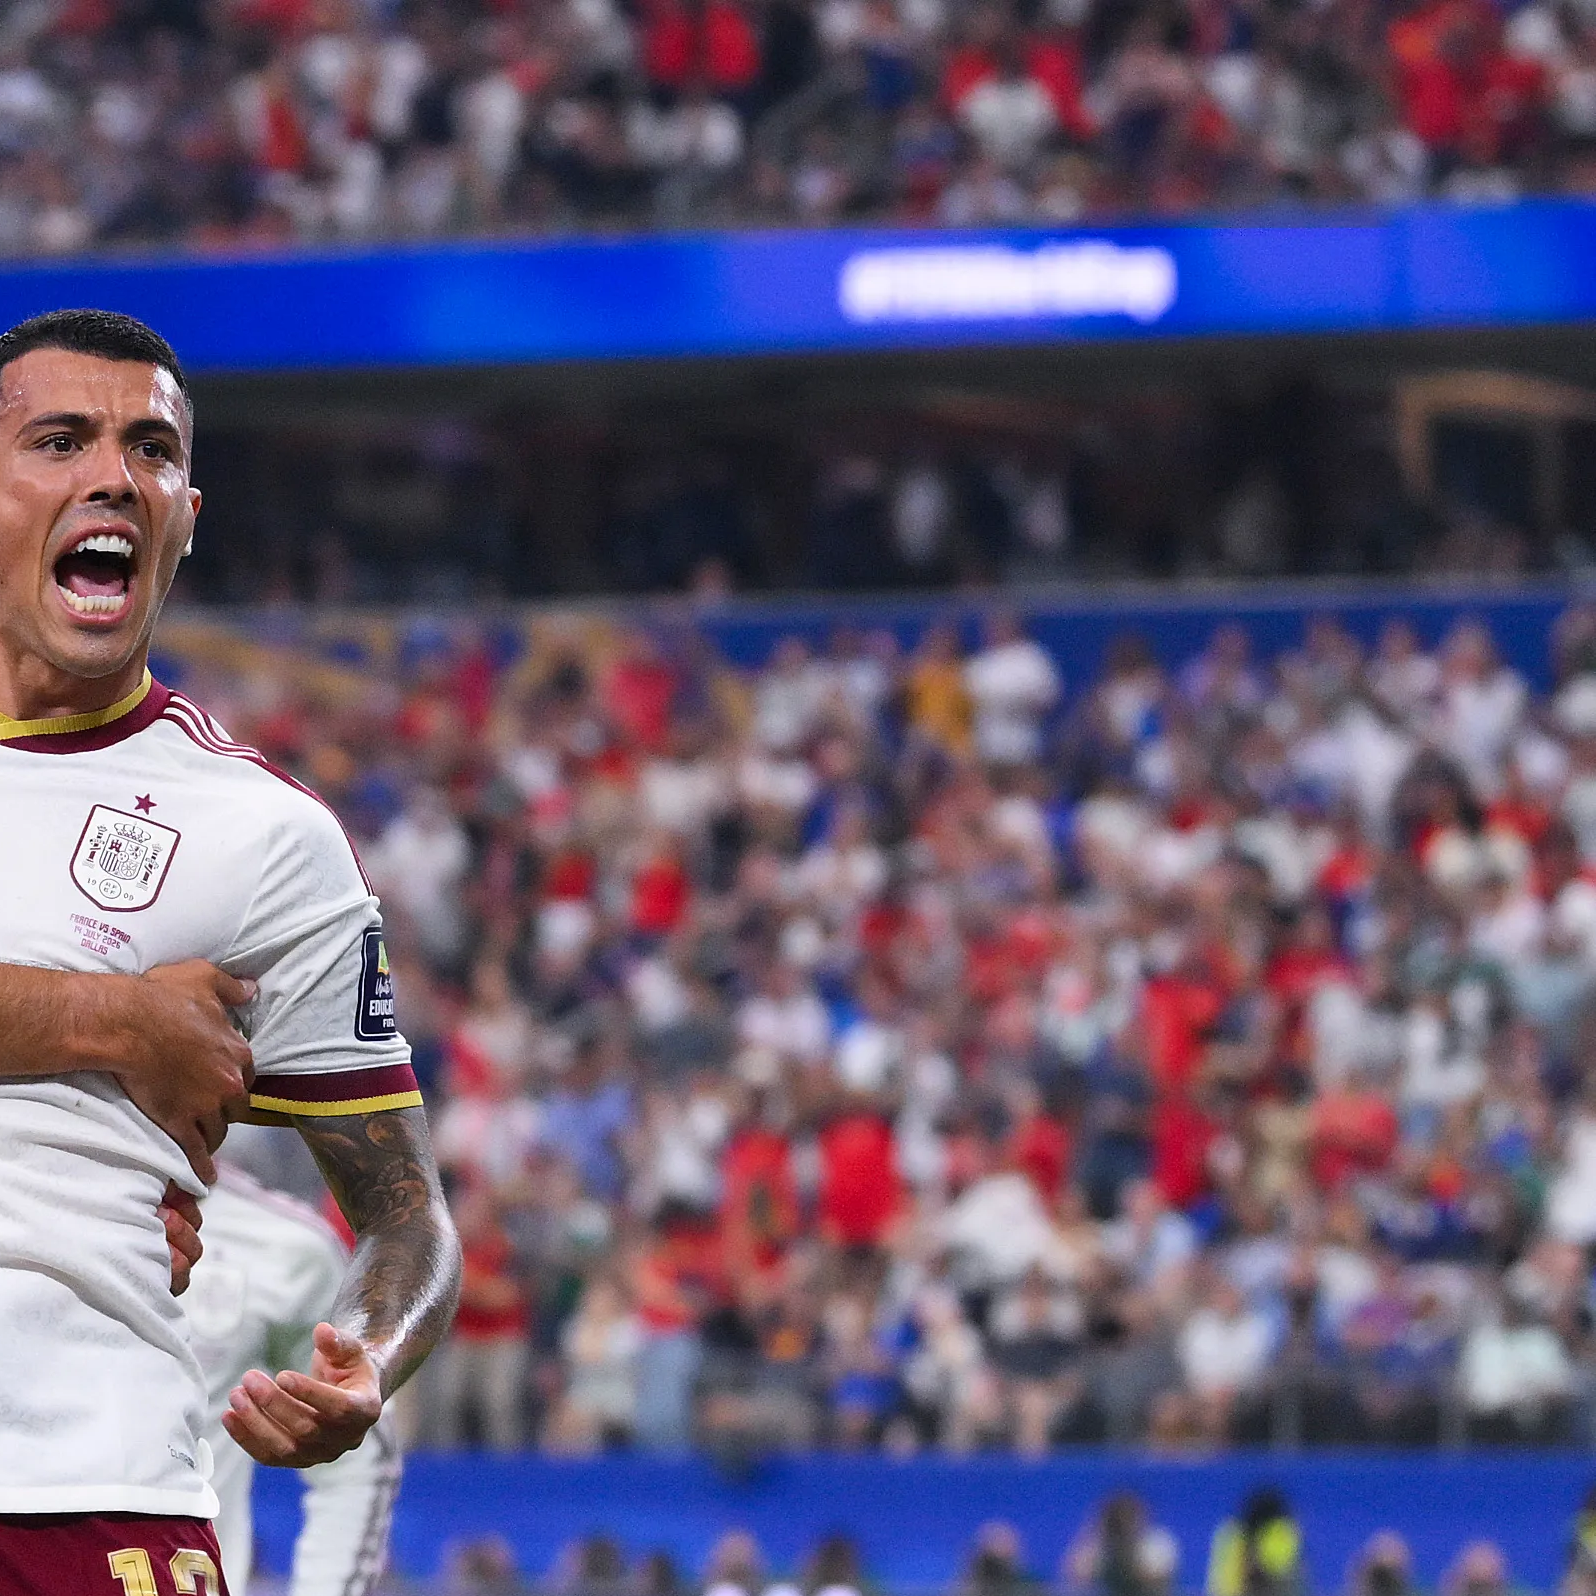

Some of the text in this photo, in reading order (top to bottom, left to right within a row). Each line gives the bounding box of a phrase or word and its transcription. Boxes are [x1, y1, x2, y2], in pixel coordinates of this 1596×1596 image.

[69, 913, 132, 944] FRANCE VS SPAIN
[83, 928, 102, 941] JULY
[102, 935, 122, 950] 2026
[80, 938, 109, 956] DALLAS
